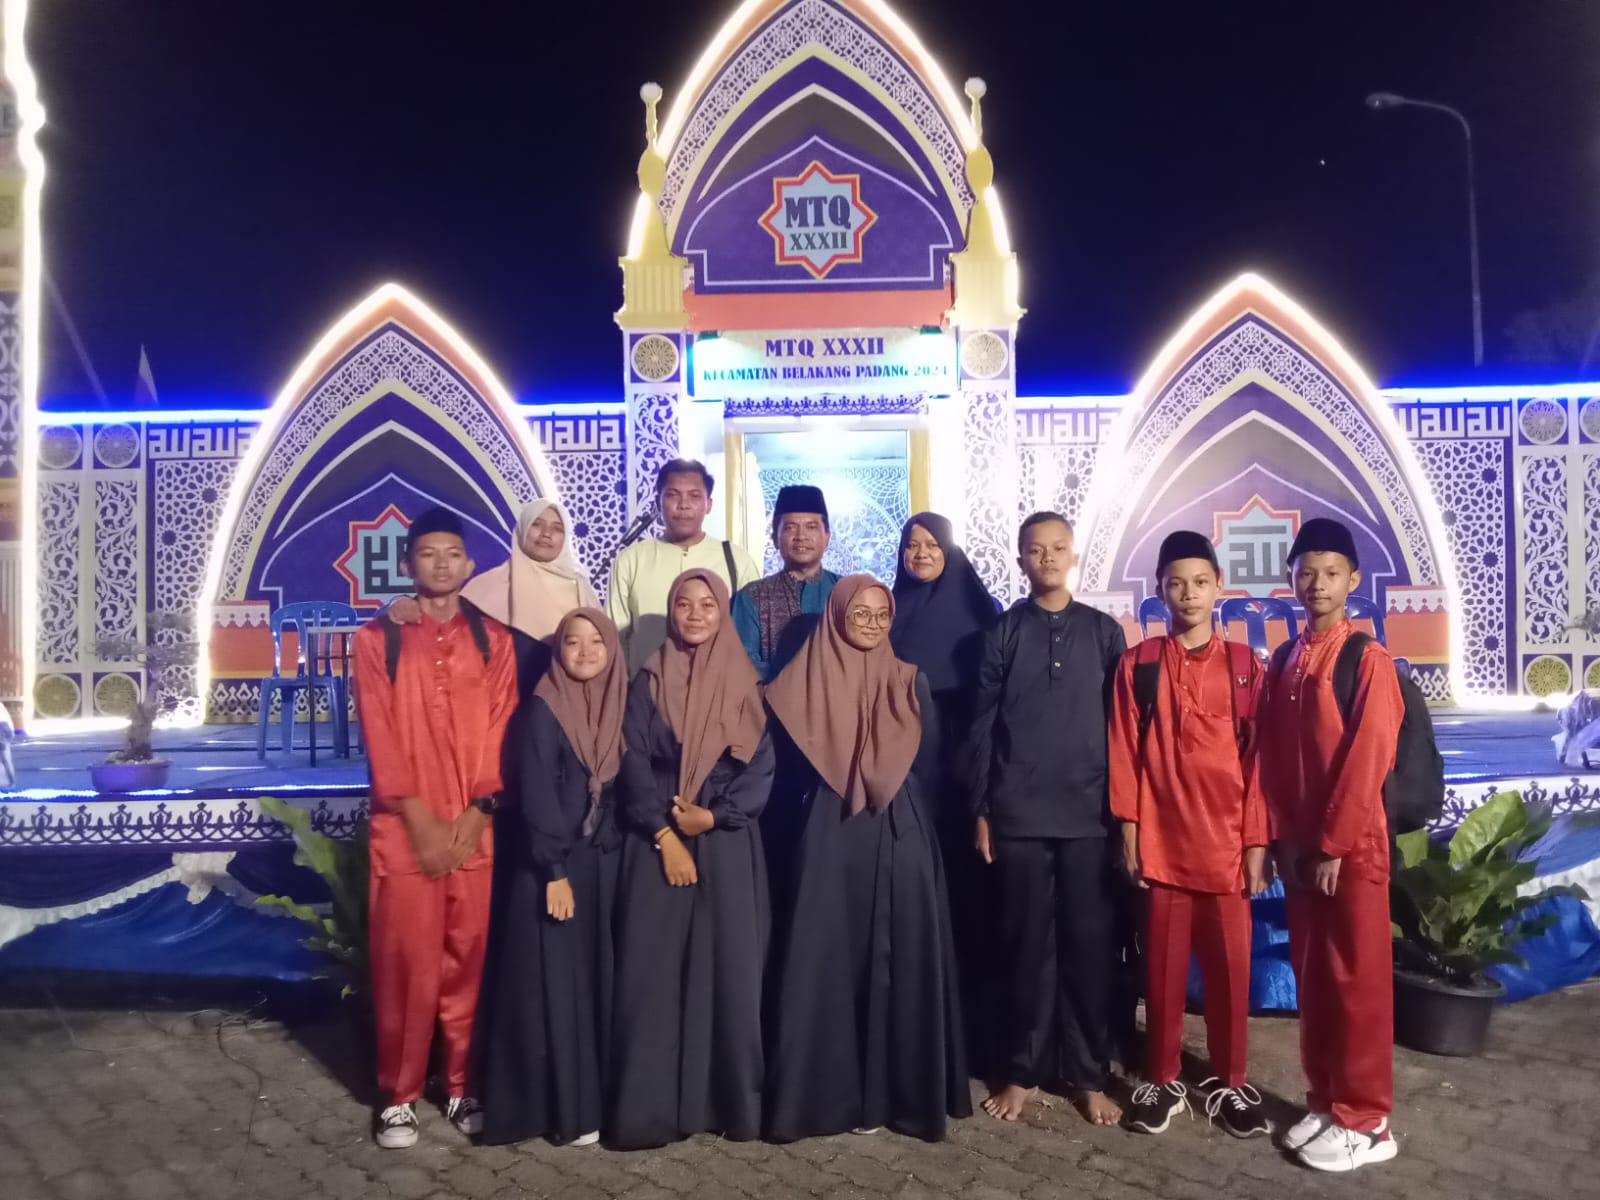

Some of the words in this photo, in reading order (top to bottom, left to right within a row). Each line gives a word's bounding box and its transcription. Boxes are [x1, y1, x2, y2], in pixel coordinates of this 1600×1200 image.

[784, 195, 851, 229] MTQ
[790, 232, 848, 250] XXXII
[765, 338, 815, 358] MTQ
[822, 337, 884, 356] XXXII
[782, 365, 851, 379] BELAKANG
[856, 364, 909, 378] PADANG
